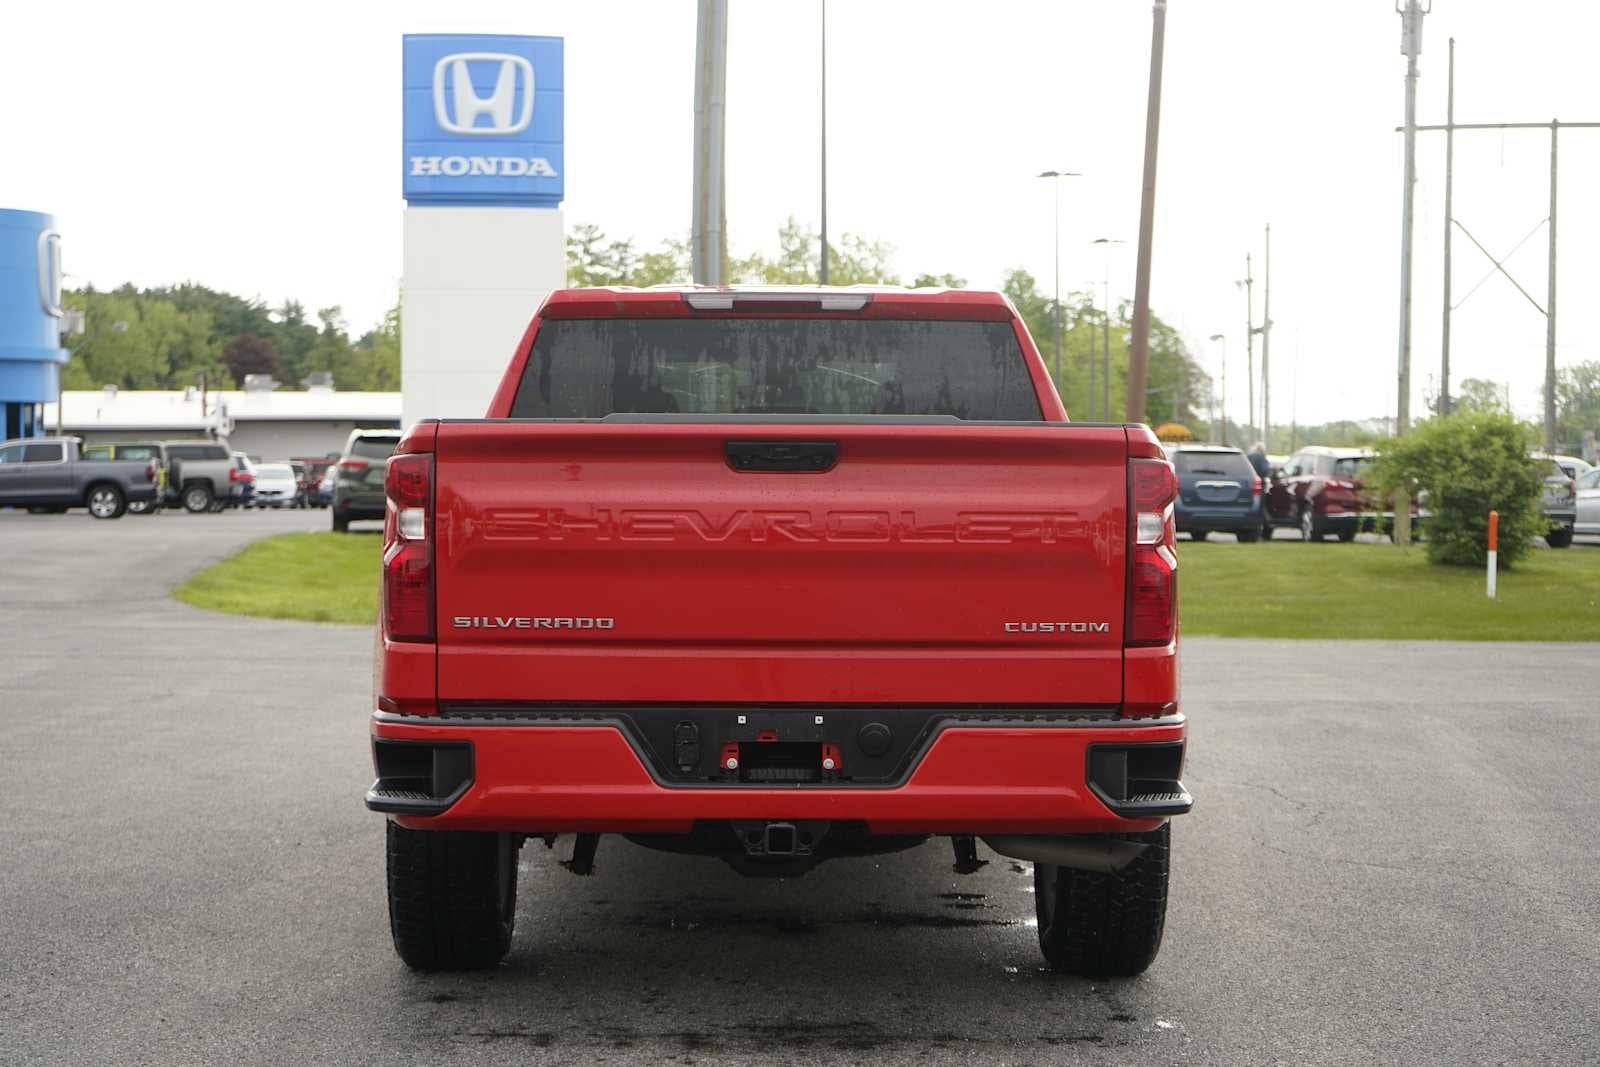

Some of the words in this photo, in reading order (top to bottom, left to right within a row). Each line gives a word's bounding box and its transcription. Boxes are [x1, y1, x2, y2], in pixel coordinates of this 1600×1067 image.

[410, 156, 557, 177] HONDA
[483, 508, 1079, 543] CHEVROLET
[453, 616, 615, 629] SILVERADO
[1003, 621, 1110, 633] CUSTOM
